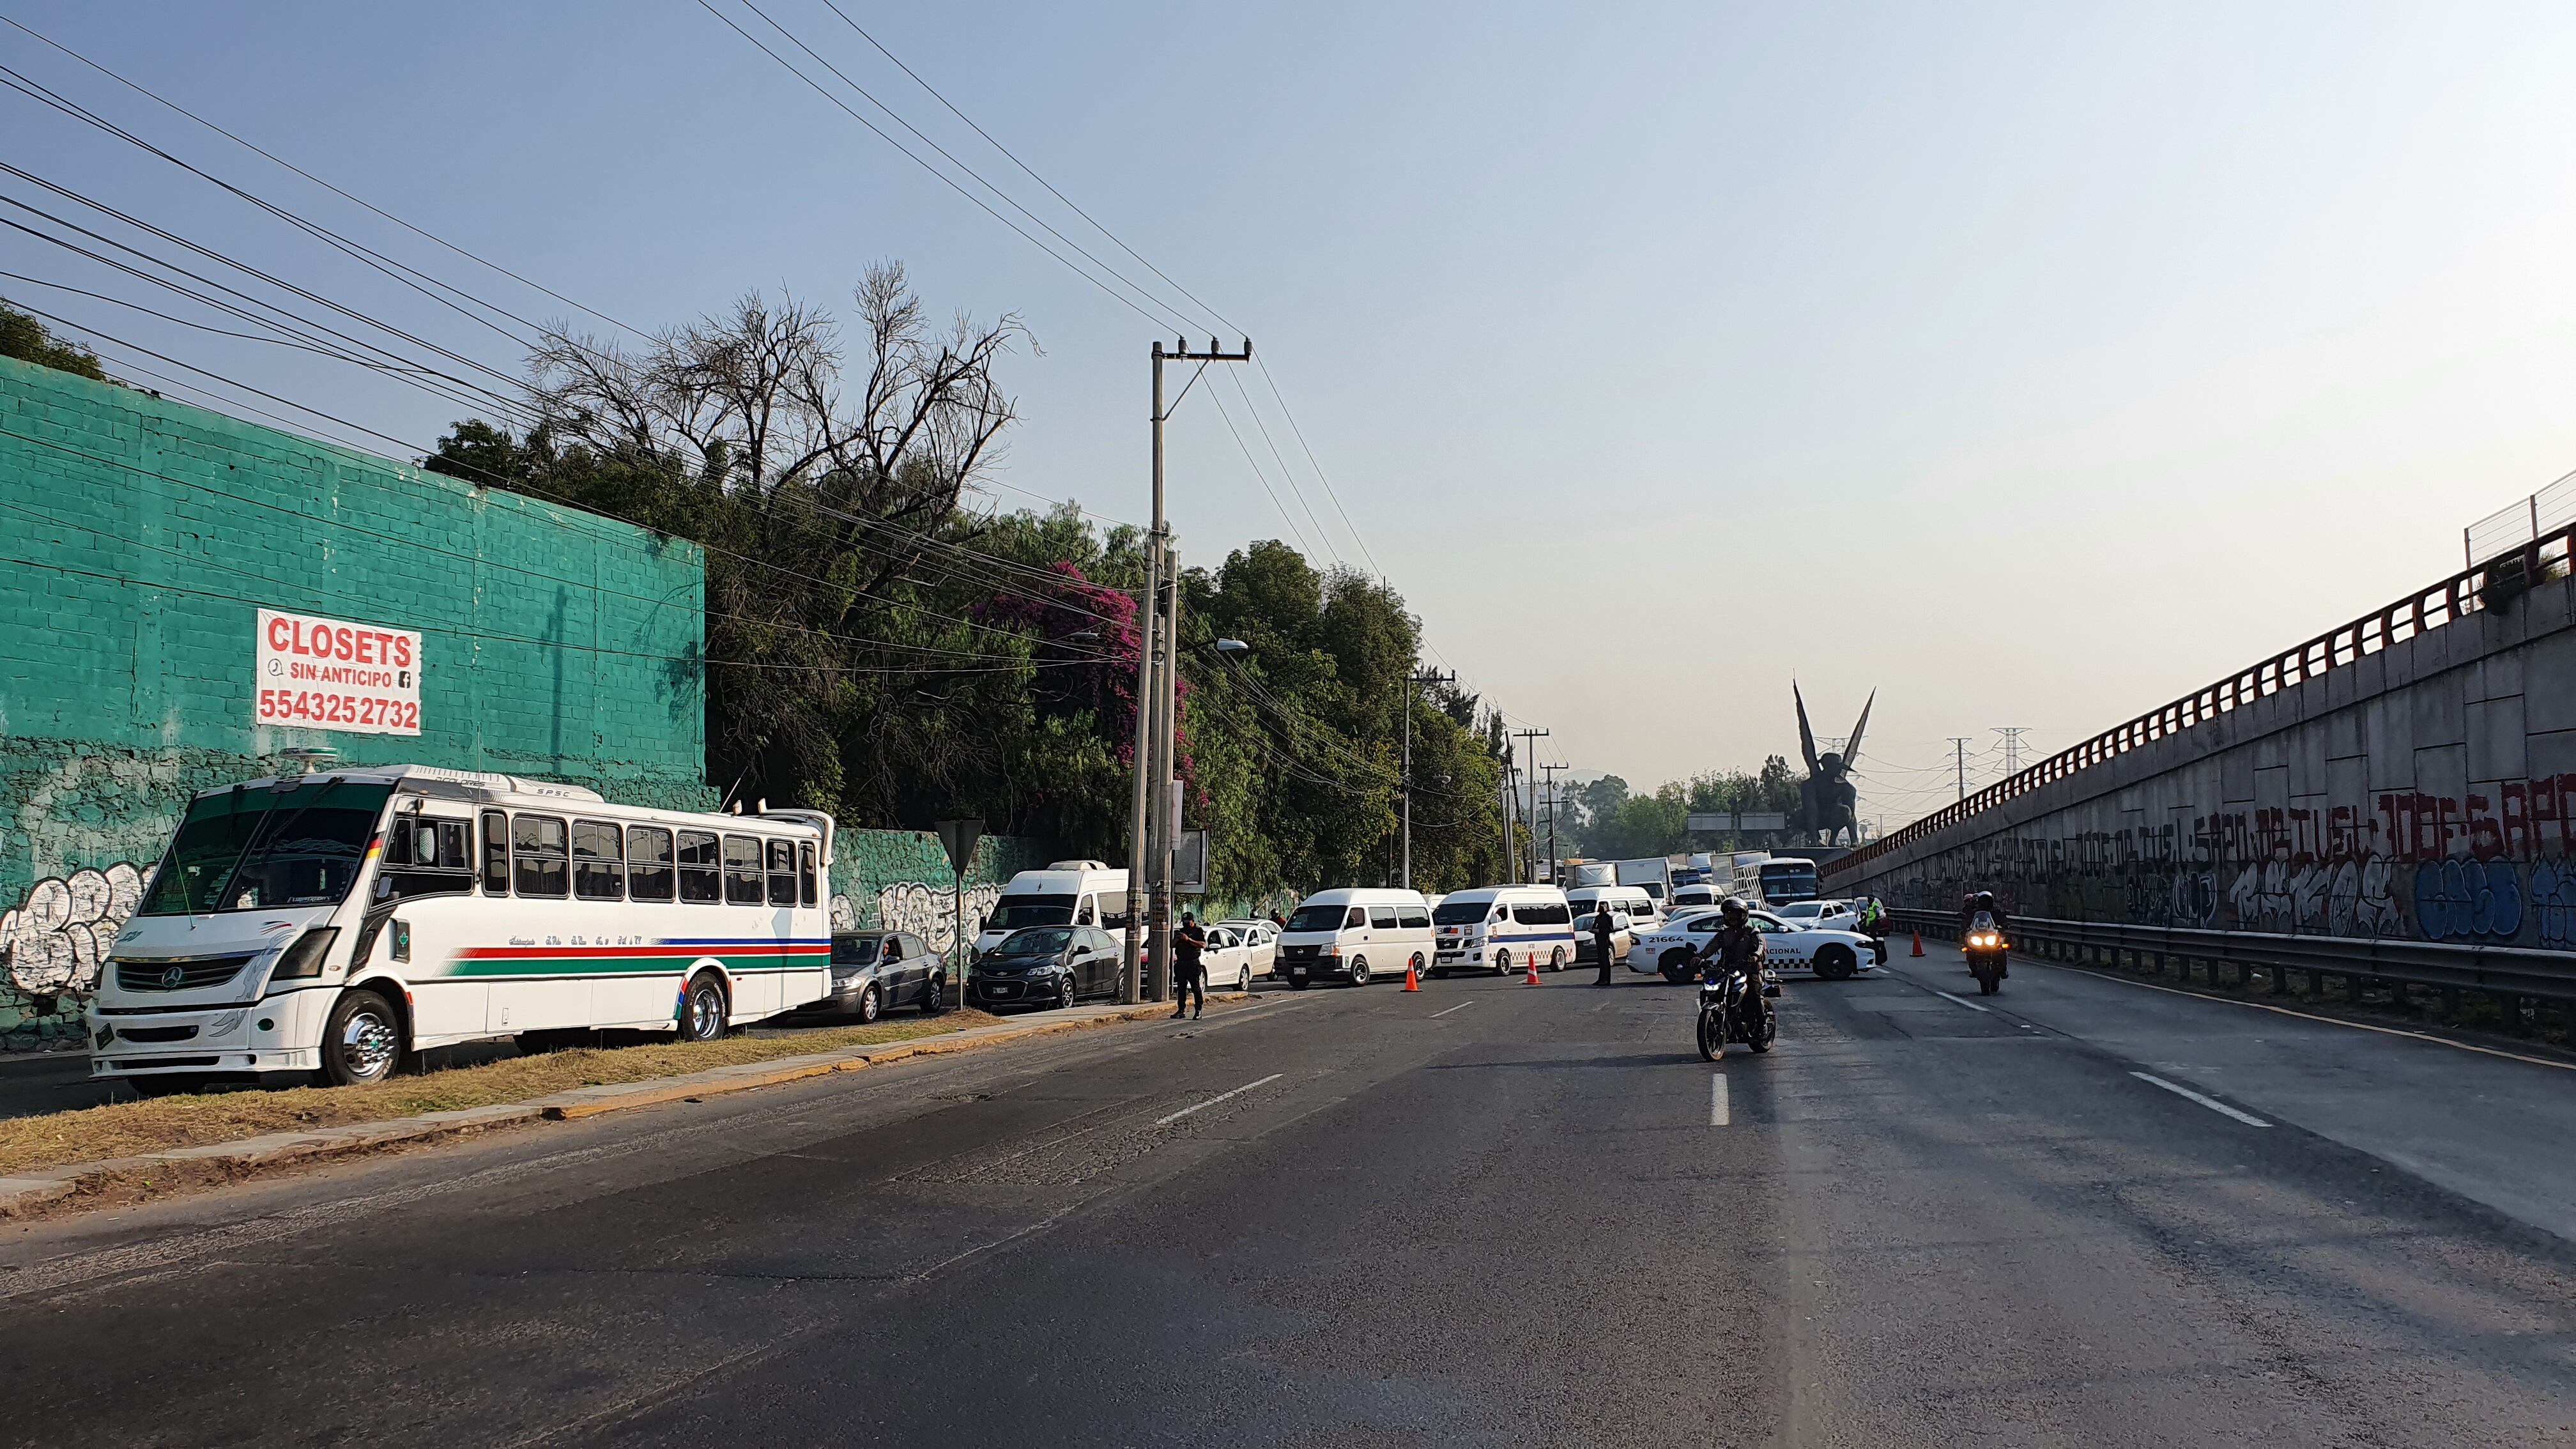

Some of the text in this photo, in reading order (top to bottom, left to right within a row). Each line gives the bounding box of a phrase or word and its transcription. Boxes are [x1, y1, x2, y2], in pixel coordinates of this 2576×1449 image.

[268, 617, 411, 668] CLOSETS
[290, 662, 317, 680] SIN
[320, 666, 392, 688] ANTICIPO
[259, 689, 417, 728] 5543252732
